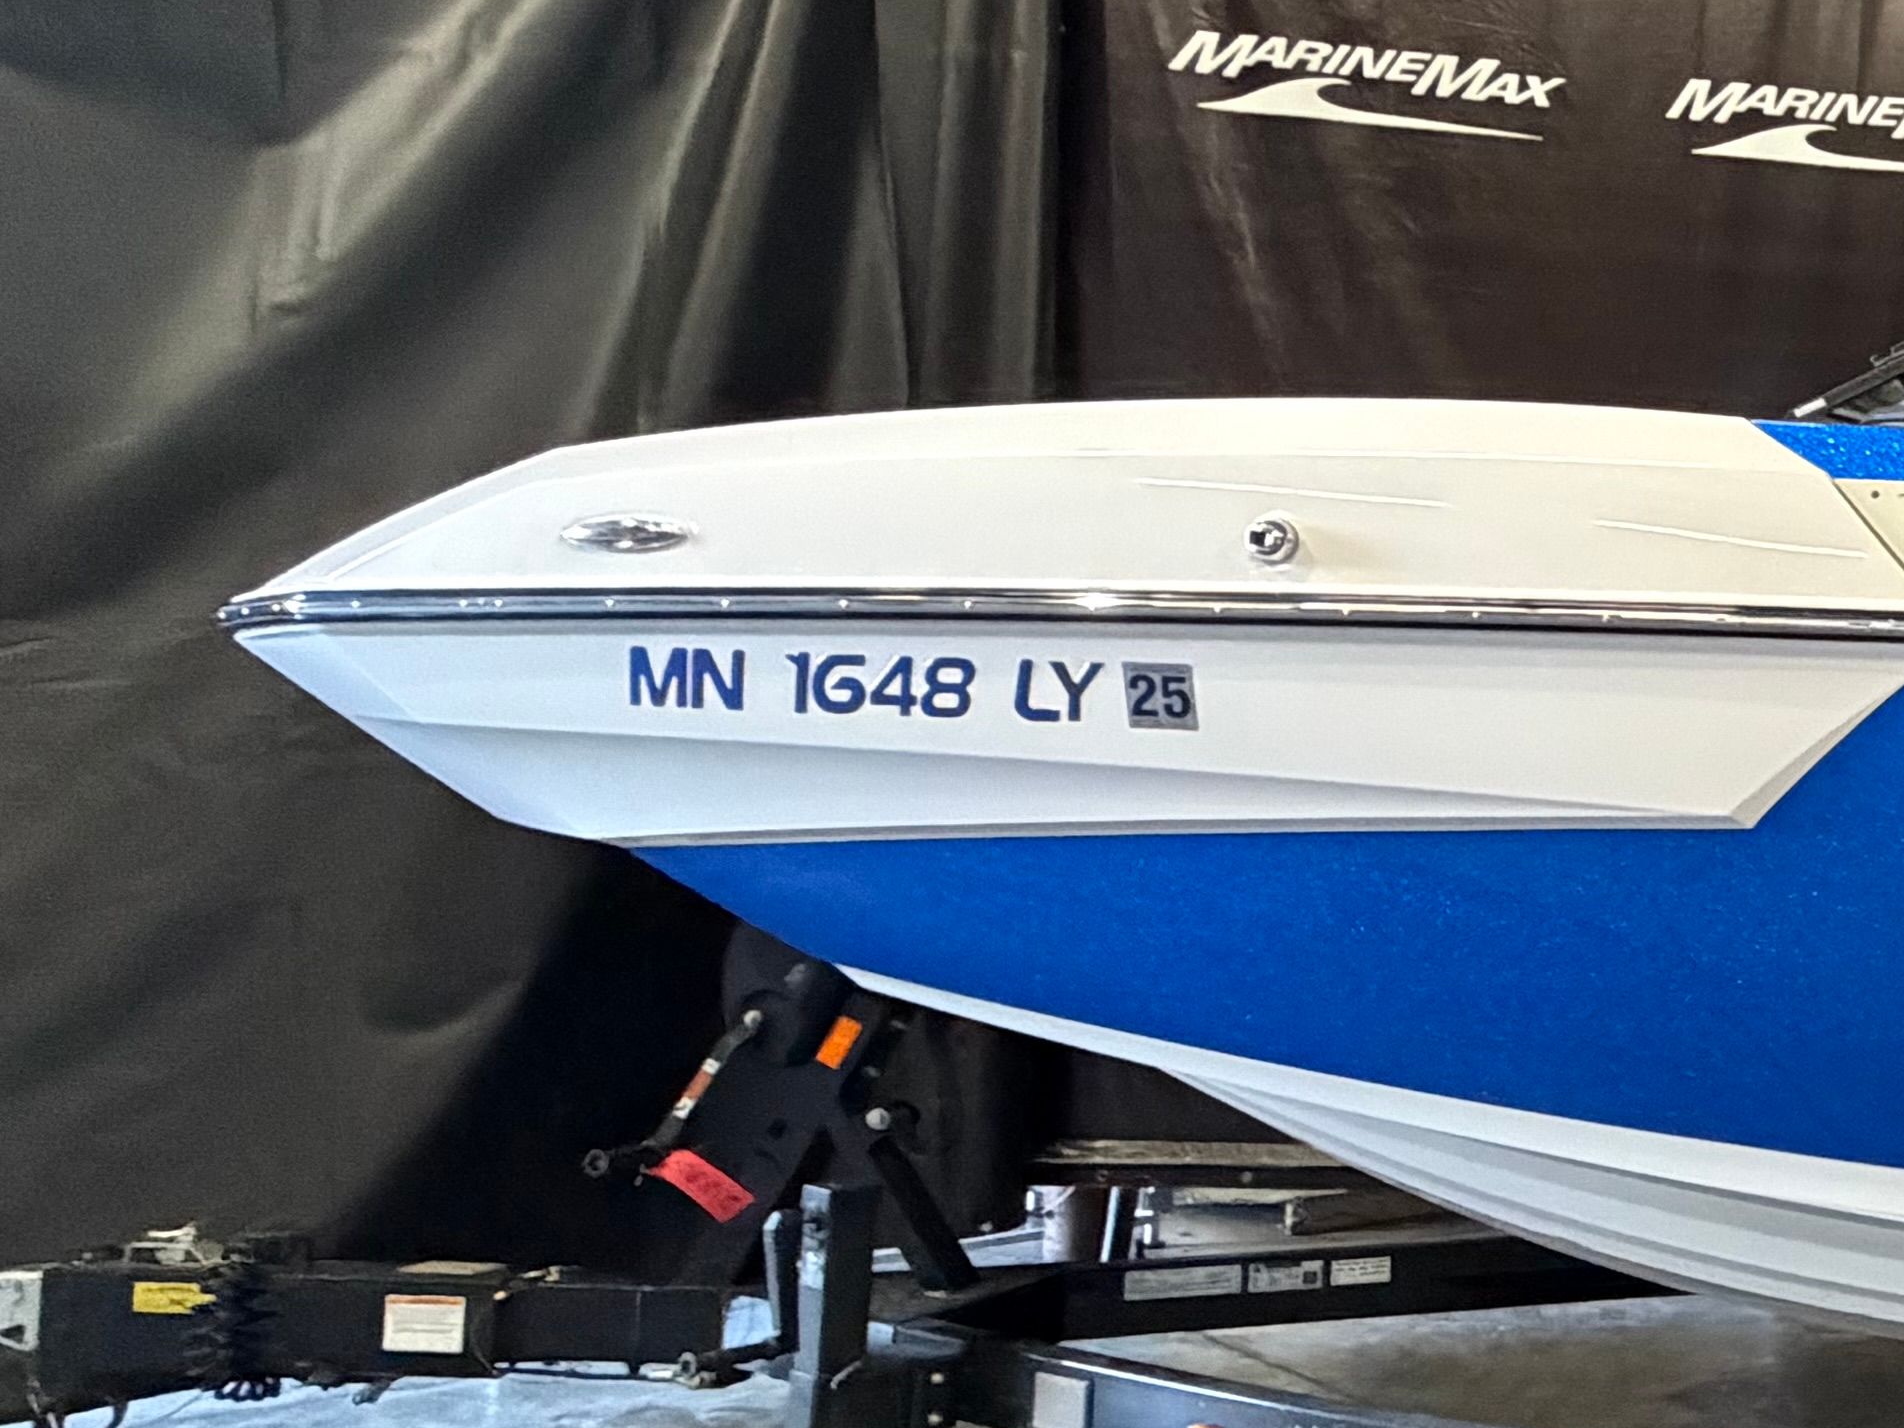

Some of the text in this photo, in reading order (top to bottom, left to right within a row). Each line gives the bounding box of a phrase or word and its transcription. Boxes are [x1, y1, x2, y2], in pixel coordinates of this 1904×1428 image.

[629, 645, 1105, 723] MN 1648 LY
[1128, 673, 1192, 719] 25
